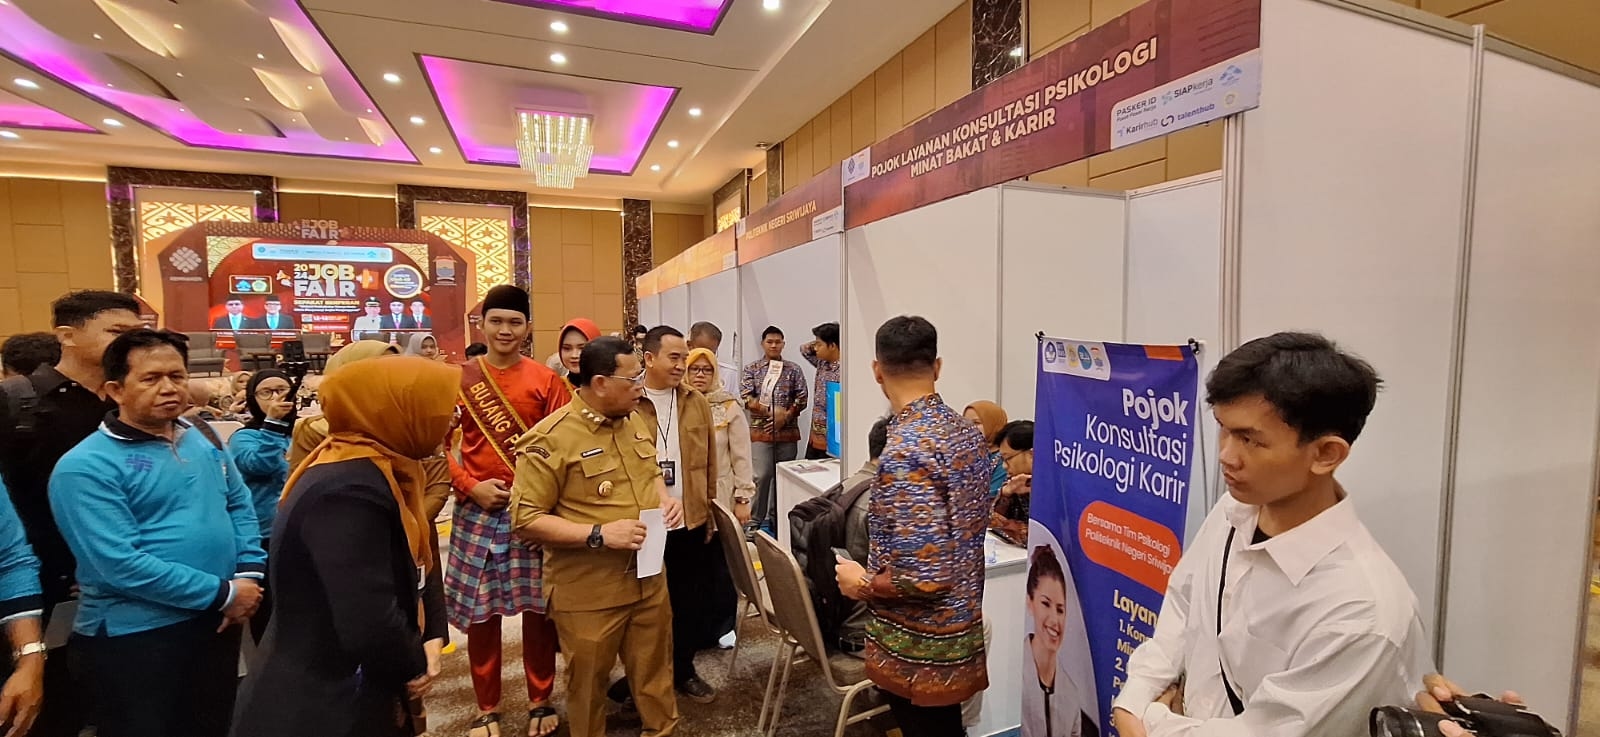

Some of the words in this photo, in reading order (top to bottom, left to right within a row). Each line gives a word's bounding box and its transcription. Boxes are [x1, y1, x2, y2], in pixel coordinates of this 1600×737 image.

[1173, 78, 1214, 99] SIAPkerja
[871, 153, 900, 178] POJOK
[901, 132, 950, 167] LAYANAN
[952, 91, 1041, 143] KONSULTASI
[1044, 36, 1158, 106] PSIKOLOGI
[1116, 99, 1147, 117] PASKER
[1177, 103, 1215, 121] talenthub
[1126, 118, 1159, 135] Karirhub
[910, 155, 944, 178] MINAT
[946, 134, 988, 165] BAKAT
[991, 130, 1002, 148] &
[1004, 107, 1056, 143] KARIR
[310, 219, 338, 230] JOB
[768, 214, 786, 230] NEGERI
[786, 199, 817, 223] SRIWIJAYA
[302, 229, 339, 239] FAIR
[294, 263, 309, 272] 20
[308, 263, 355, 281] JOB
[294, 271, 308, 280] 24
[294, 280, 356, 297] FAIR
[470, 381, 511, 433] BUJANG
[1122, 388, 1188, 430] Pojok
[1085, 413, 1187, 466] Konsultasi
[1054, 439, 1135, 493] Psikologi
[1139, 462, 1186, 505] Karir
[1087, 512, 1122, 534] Bersama
[1122, 525, 1137, 541] Tim
[1137, 532, 1171, 558] Psikologi
[1085, 528, 1121, 551] Politeknik
[1121, 542, 1146, 561] Negeri
[1147, 553, 1173, 575] Sriwija
[1127, 623, 1152, 642] Kon
